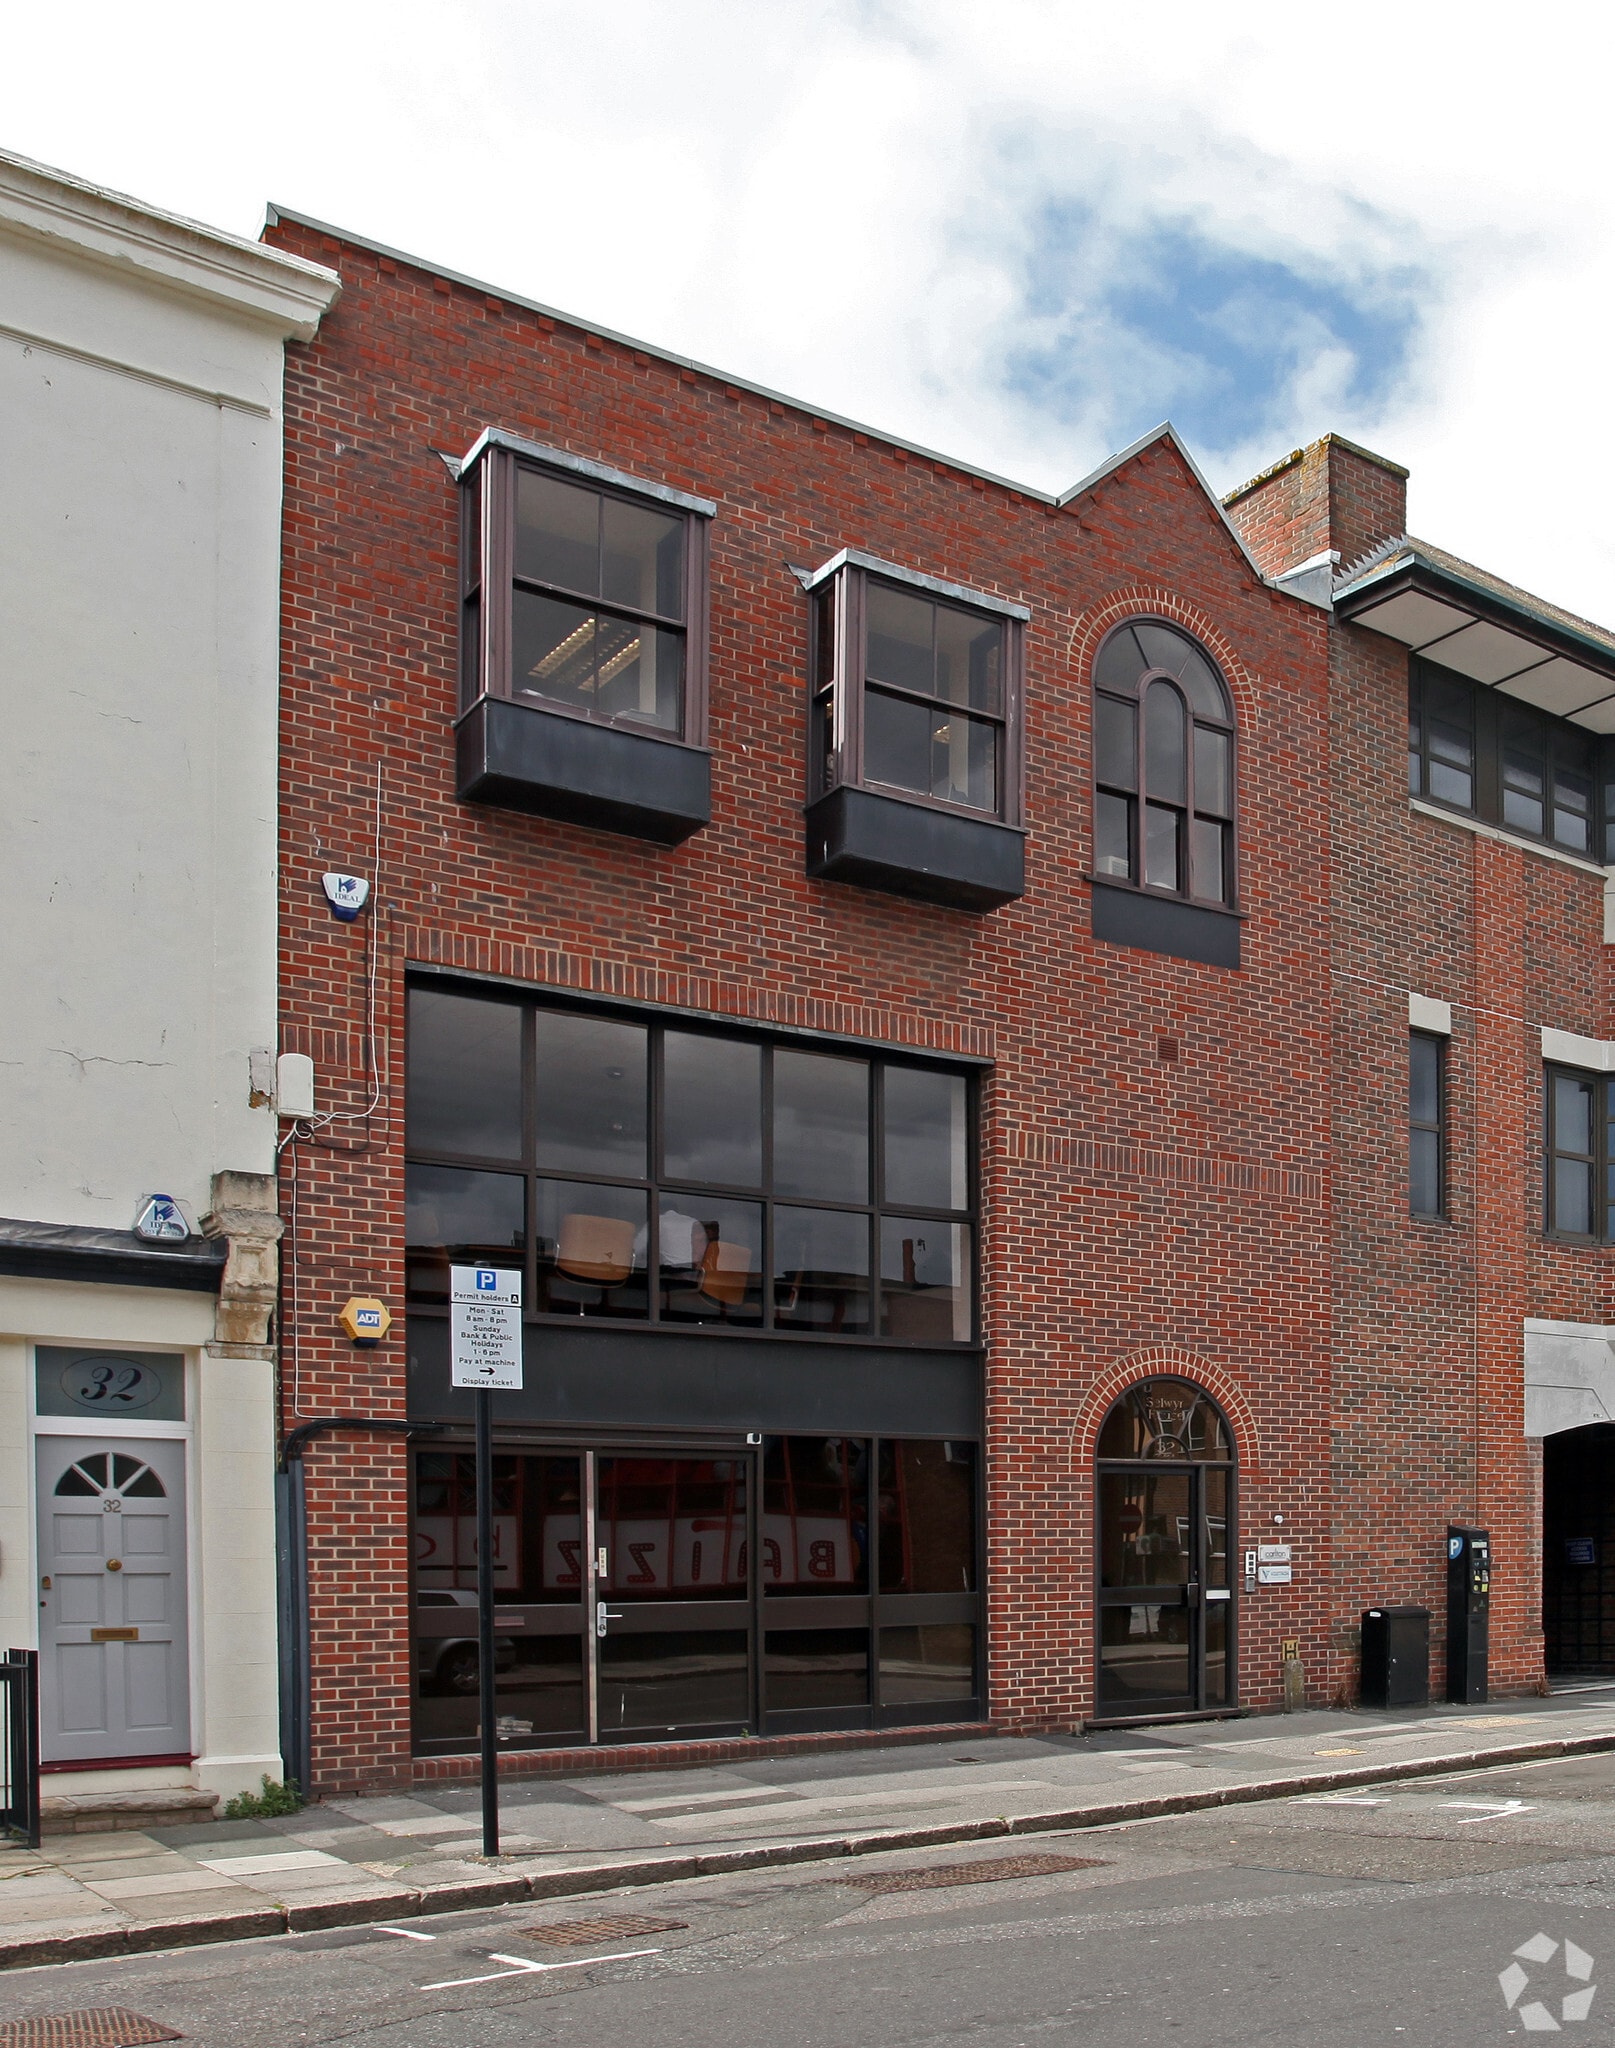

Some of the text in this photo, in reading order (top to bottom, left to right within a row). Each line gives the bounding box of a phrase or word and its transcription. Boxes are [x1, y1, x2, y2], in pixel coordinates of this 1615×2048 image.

[334, 893, 361, 903] IDEAL
[481, 1273, 494, 1289] P
[454, 1291, 519, 1304] Permit holders A
[469, 1306, 486, 1314] Mon
[491, 1307, 504, 1315] Sat
[357, 1312, 381, 1325] ADT
[473, 1325, 501, 1333] Sunday
[461, 1332, 480, 1340] Bank
[490, 1333, 513, 1342] Public
[471, 1340, 504, 1349] Holidays
[459, 1357, 516, 1367] Pay at machine
[80, 1366, 143, 1402] 32
[462, 1377, 514, 1387] Display ticket
[103, 1499, 122, 1513] 32
[1450, 1539, 1460, 1556] P
[1284, 1642, 1298, 1661] H
